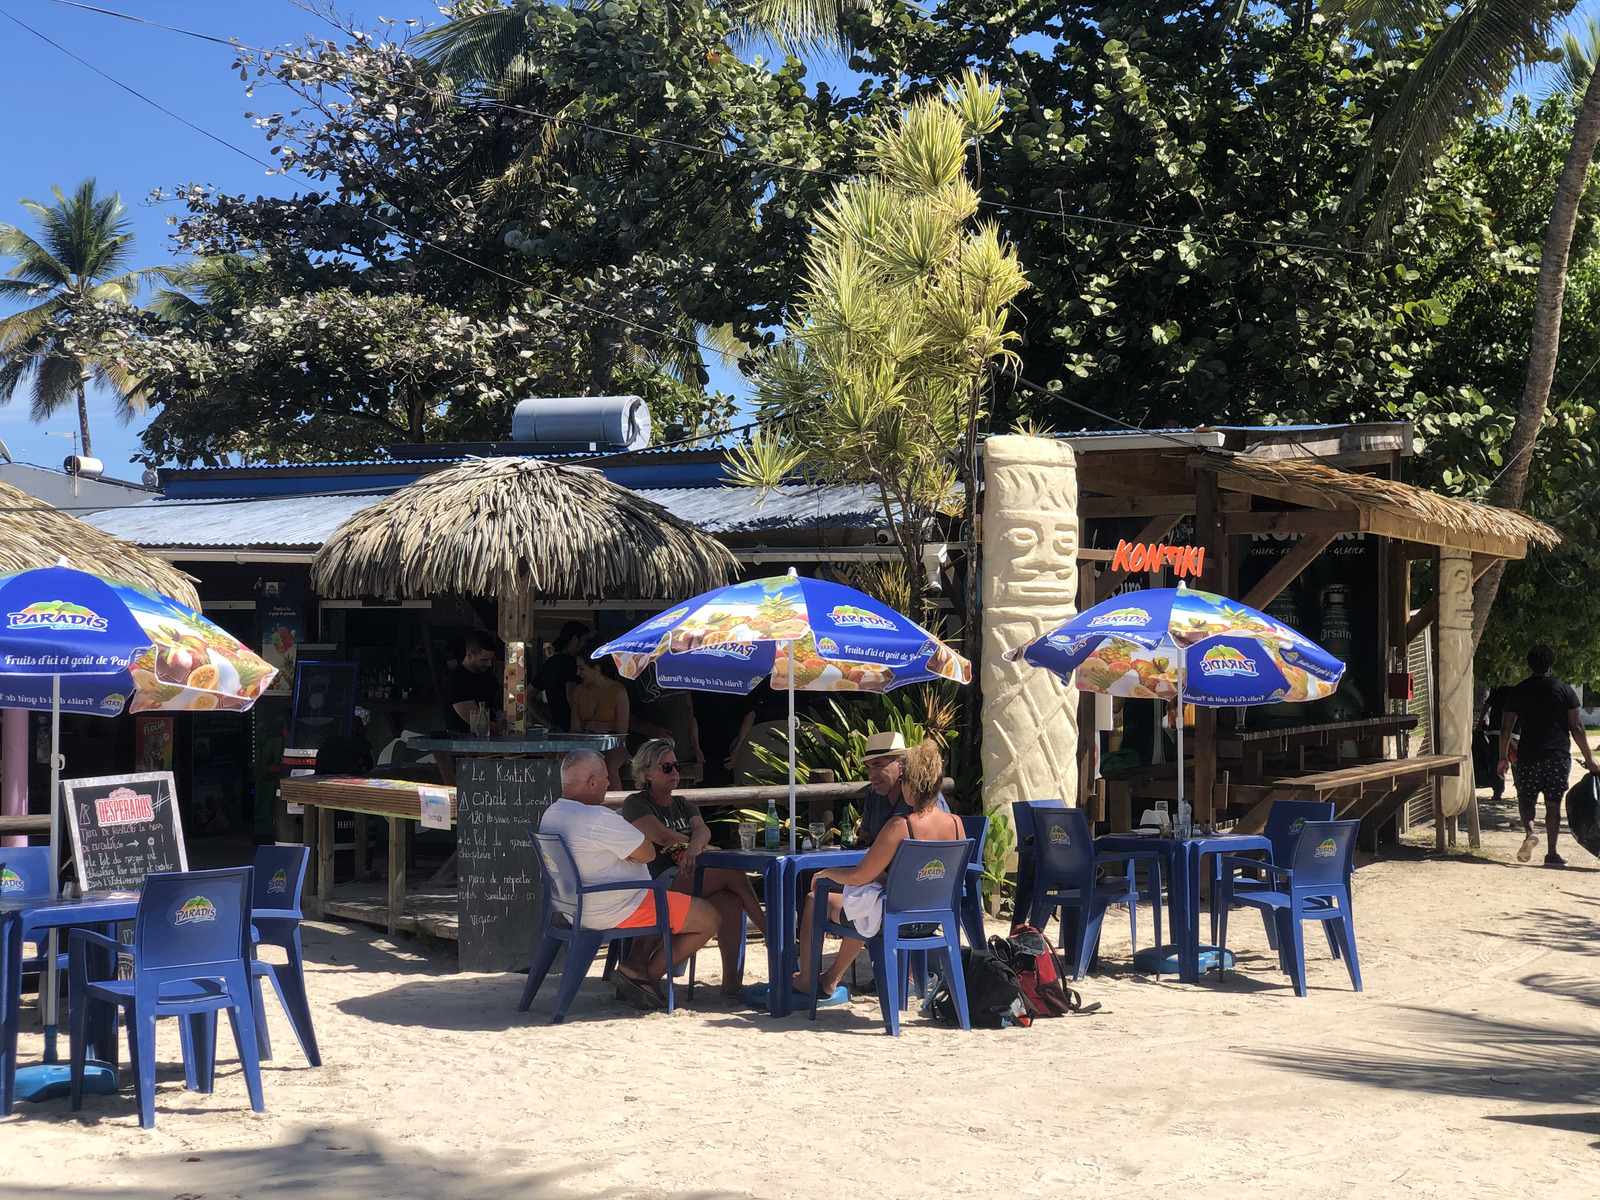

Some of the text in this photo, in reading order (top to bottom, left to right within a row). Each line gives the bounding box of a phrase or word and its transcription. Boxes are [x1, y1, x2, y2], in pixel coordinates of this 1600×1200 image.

[1111, 538, 1205, 578] KONTIKI
[5, 654, 36, 666] Fruits
[38, 654, 58, 666] d'ici
[60, 656, 70, 666] et
[71, 655, 94, 668] goût
[95, 656, 109, 665] de
[844, 645, 864, 656] Fruits
[865, 647, 878, 657] d'ici
[878, 650, 884, 658] et
[885, 650, 899, 661] goût
[900, 652, 908, 660] de
[471, 761, 486, 781] Le
[98, 797, 153, 823] DESPERADOS
[467, 810, 484, 825] 120
